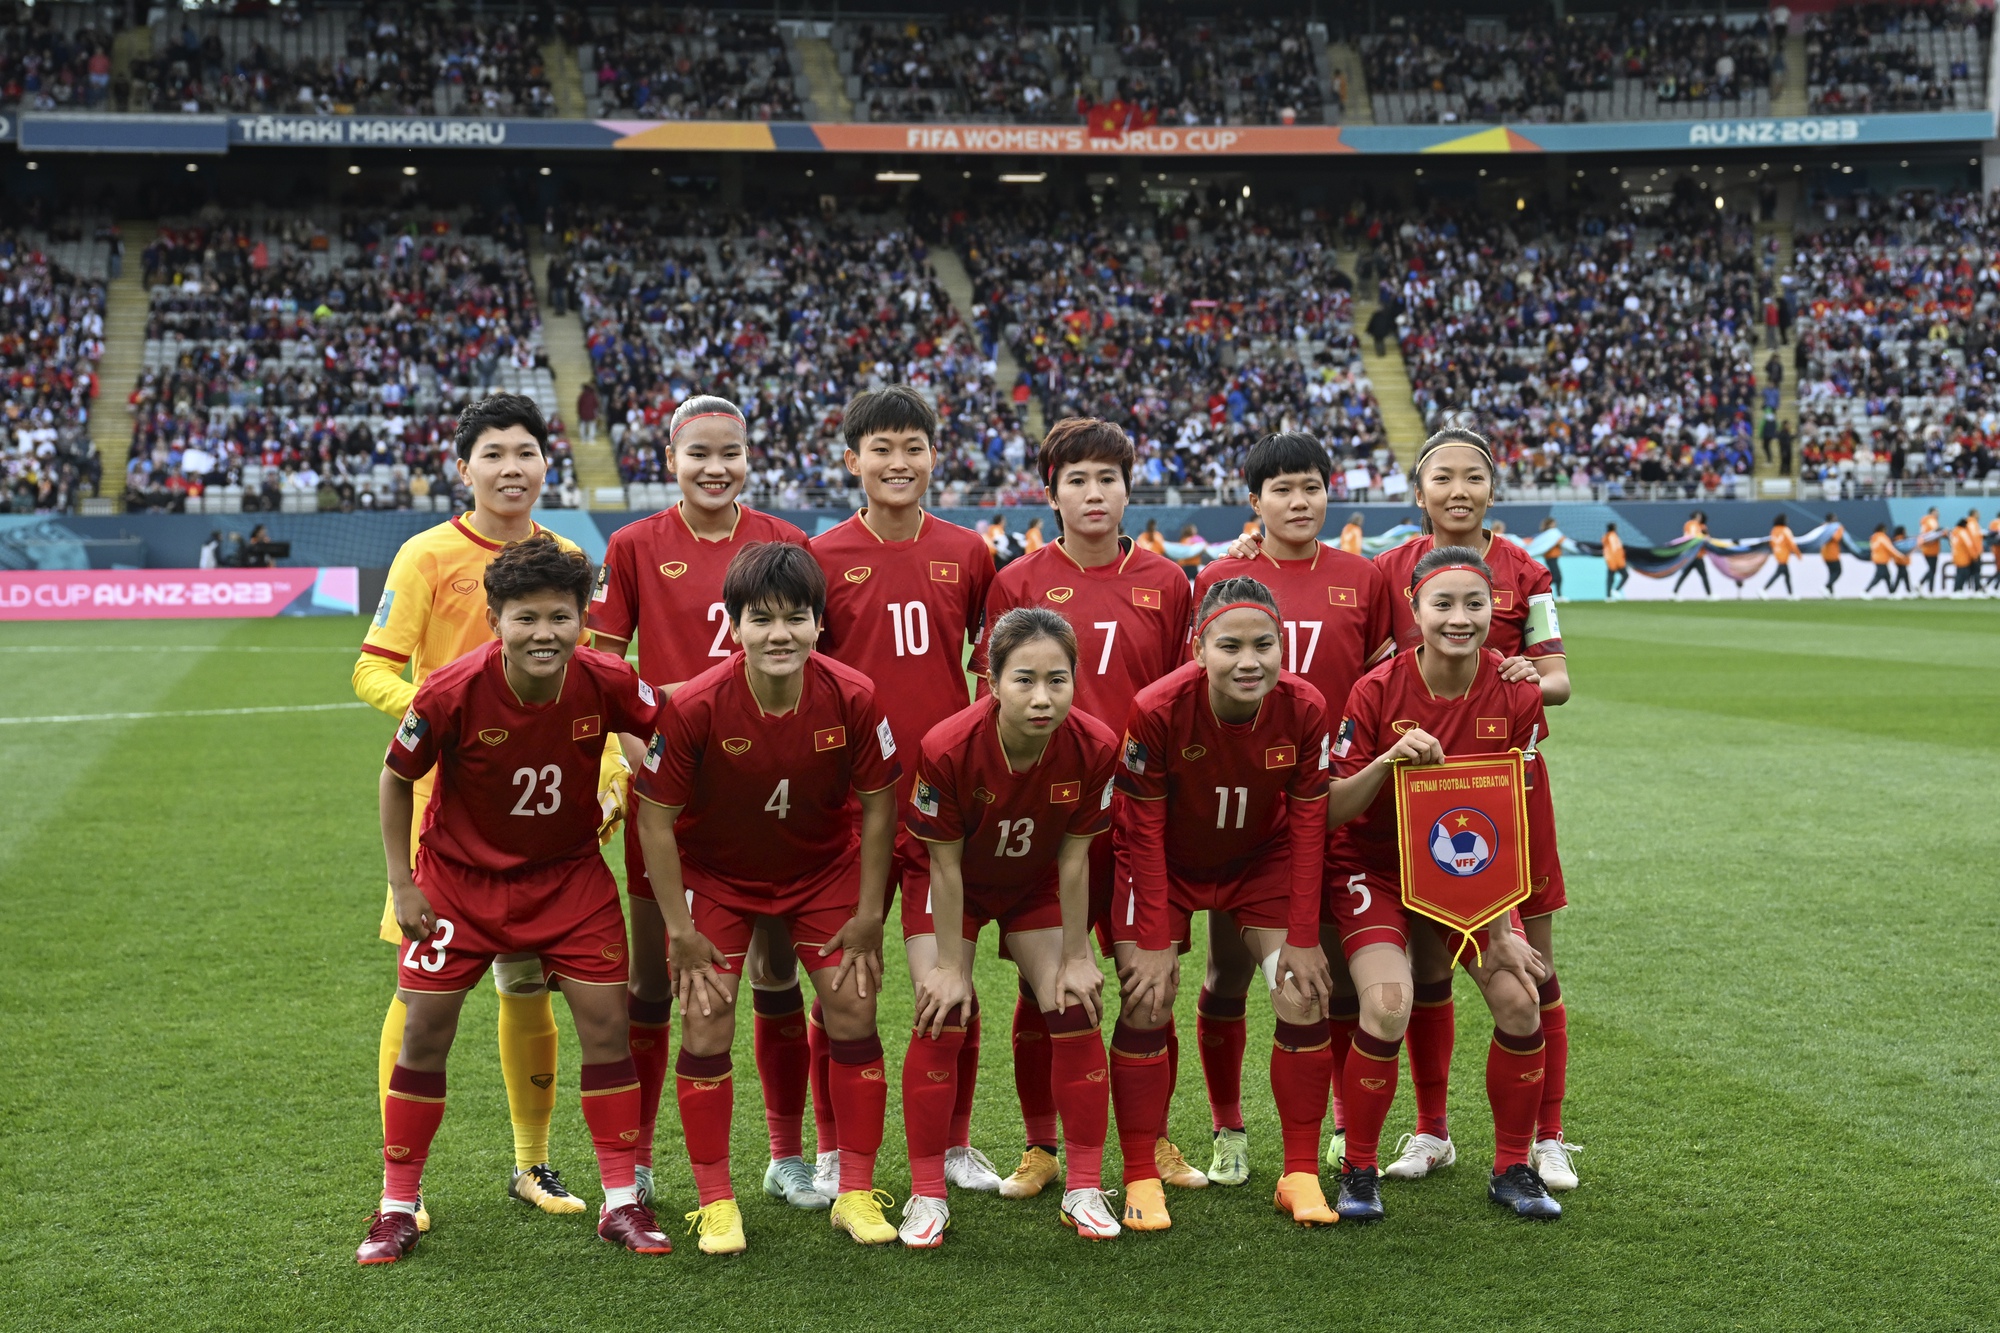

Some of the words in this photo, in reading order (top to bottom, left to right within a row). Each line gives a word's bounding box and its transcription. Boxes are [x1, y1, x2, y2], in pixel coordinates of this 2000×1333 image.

[239, 116, 343, 142] TĀMAKI
[349, 120, 506, 145] MAKAURAU
[907, 129, 960, 149] FIFA
[963, 130, 1083, 150] WOMEN'S
[1185, 131, 1238, 151] CUP
[34, 584, 92, 607] CUP
[707, 602, 732, 657] 2
[880, 601, 929, 656] 10
[1094, 621, 1118, 675] 7
[1283, 620, 1323, 674] 17
[510, 764, 562, 817] 23
[764, 779, 791, 819] 4
[1410, 780, 1438, 792] VIETNAM
[1439, 777, 1470, 790] FOOTBALL
[1472, 775, 1509, 788] FEDERATION
[1215, 786, 1248, 829] 11
[995, 817, 1035, 857] 13
[1455, 858, 1476, 867] VFF
[1346, 872, 1372, 916] 5
